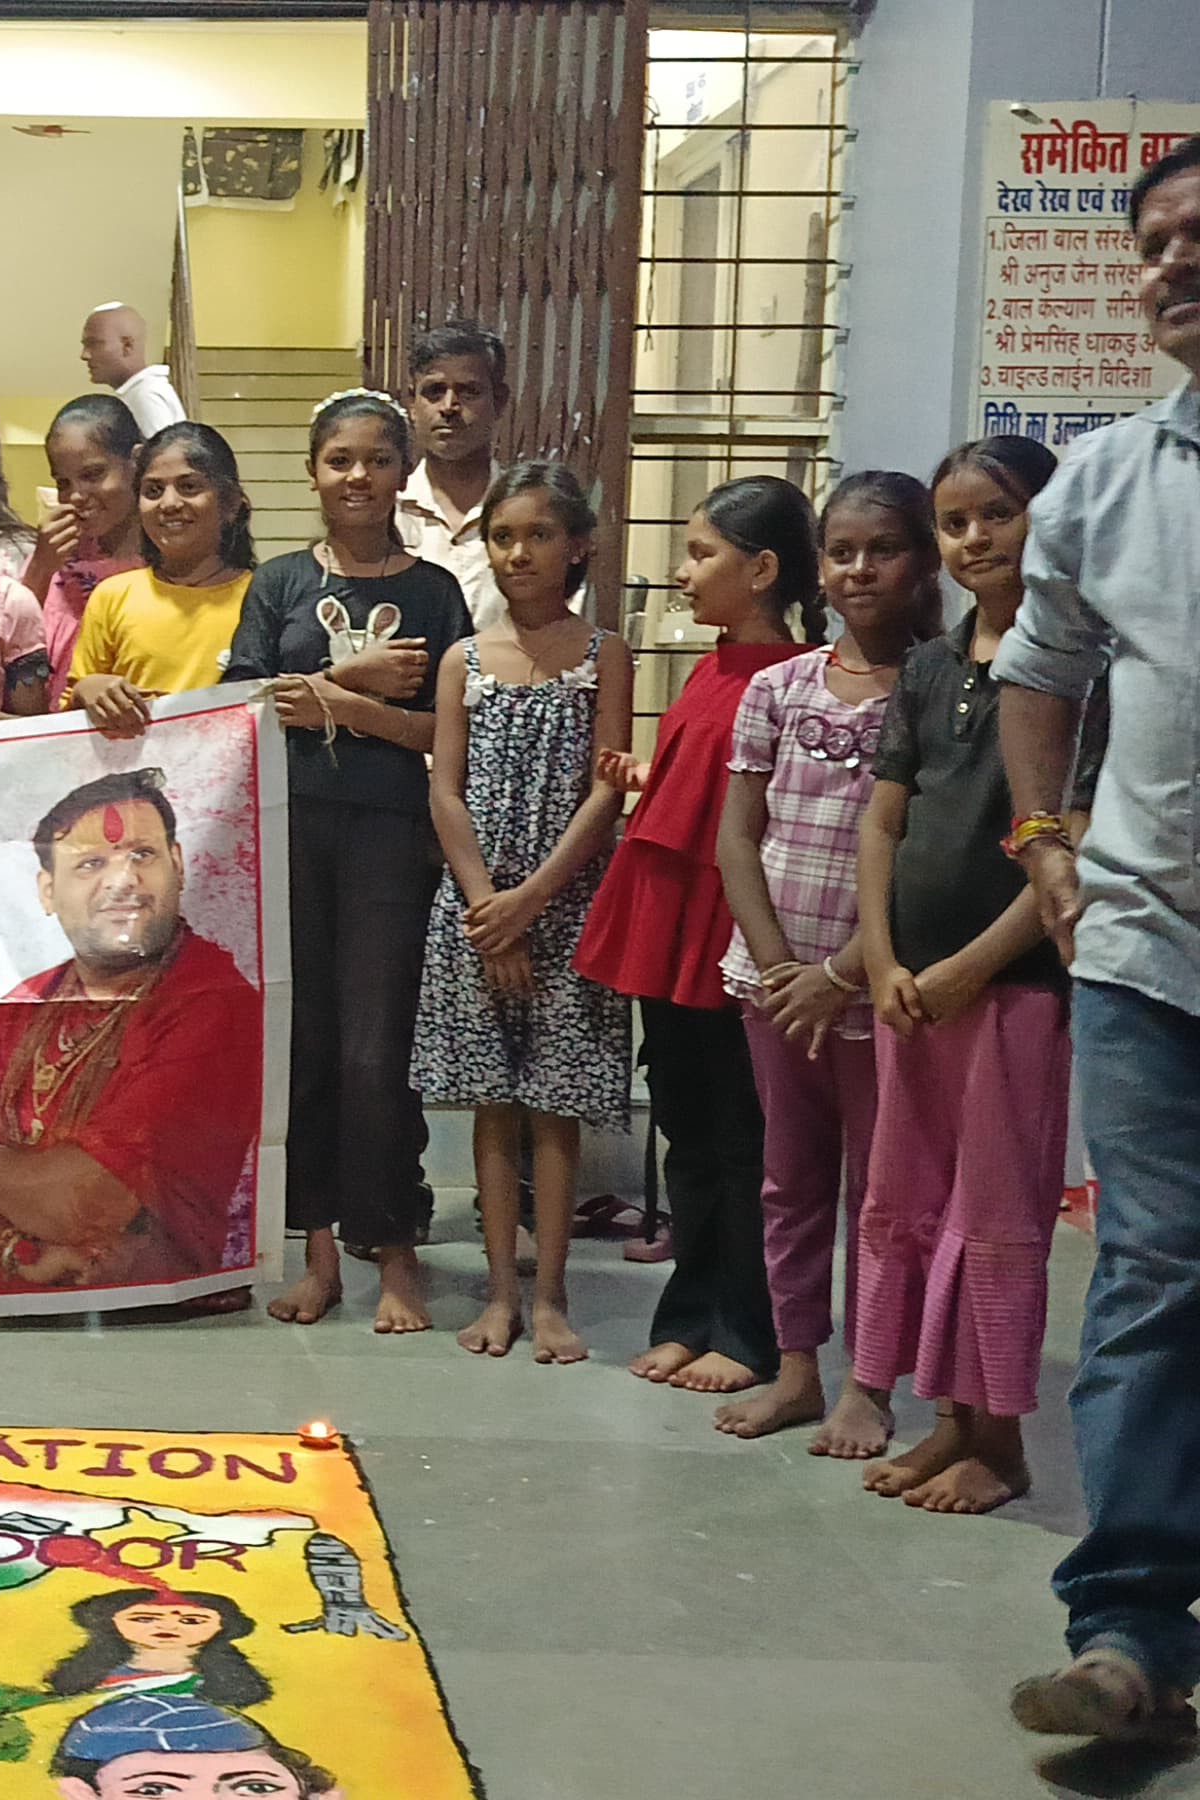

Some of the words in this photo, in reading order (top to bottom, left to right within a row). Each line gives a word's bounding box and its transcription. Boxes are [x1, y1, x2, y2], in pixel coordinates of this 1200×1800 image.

[1020, 119, 1129, 174] समेकित
[1140, 132, 1198, 169] बा
[997, 180, 1033, 213] देख
[1036, 180, 1071, 212] रेख
[1077, 182, 1104, 213] एवं
[1054, 228, 1089, 251] बाल
[1000, 256, 1020, 287] श्री
[1024, 263, 1066, 293] अनुज
[1071, 256, 1099, 285] जैन
[1038, 298, 1097, 320] कल्याण
[996, 324, 1017, 354] श्री
[1021, 324, 1080, 356] प्रेमसिंह
[1052, 358, 1095, 391] लाईन
[1099, 358, 1153, 388] विदिशा
